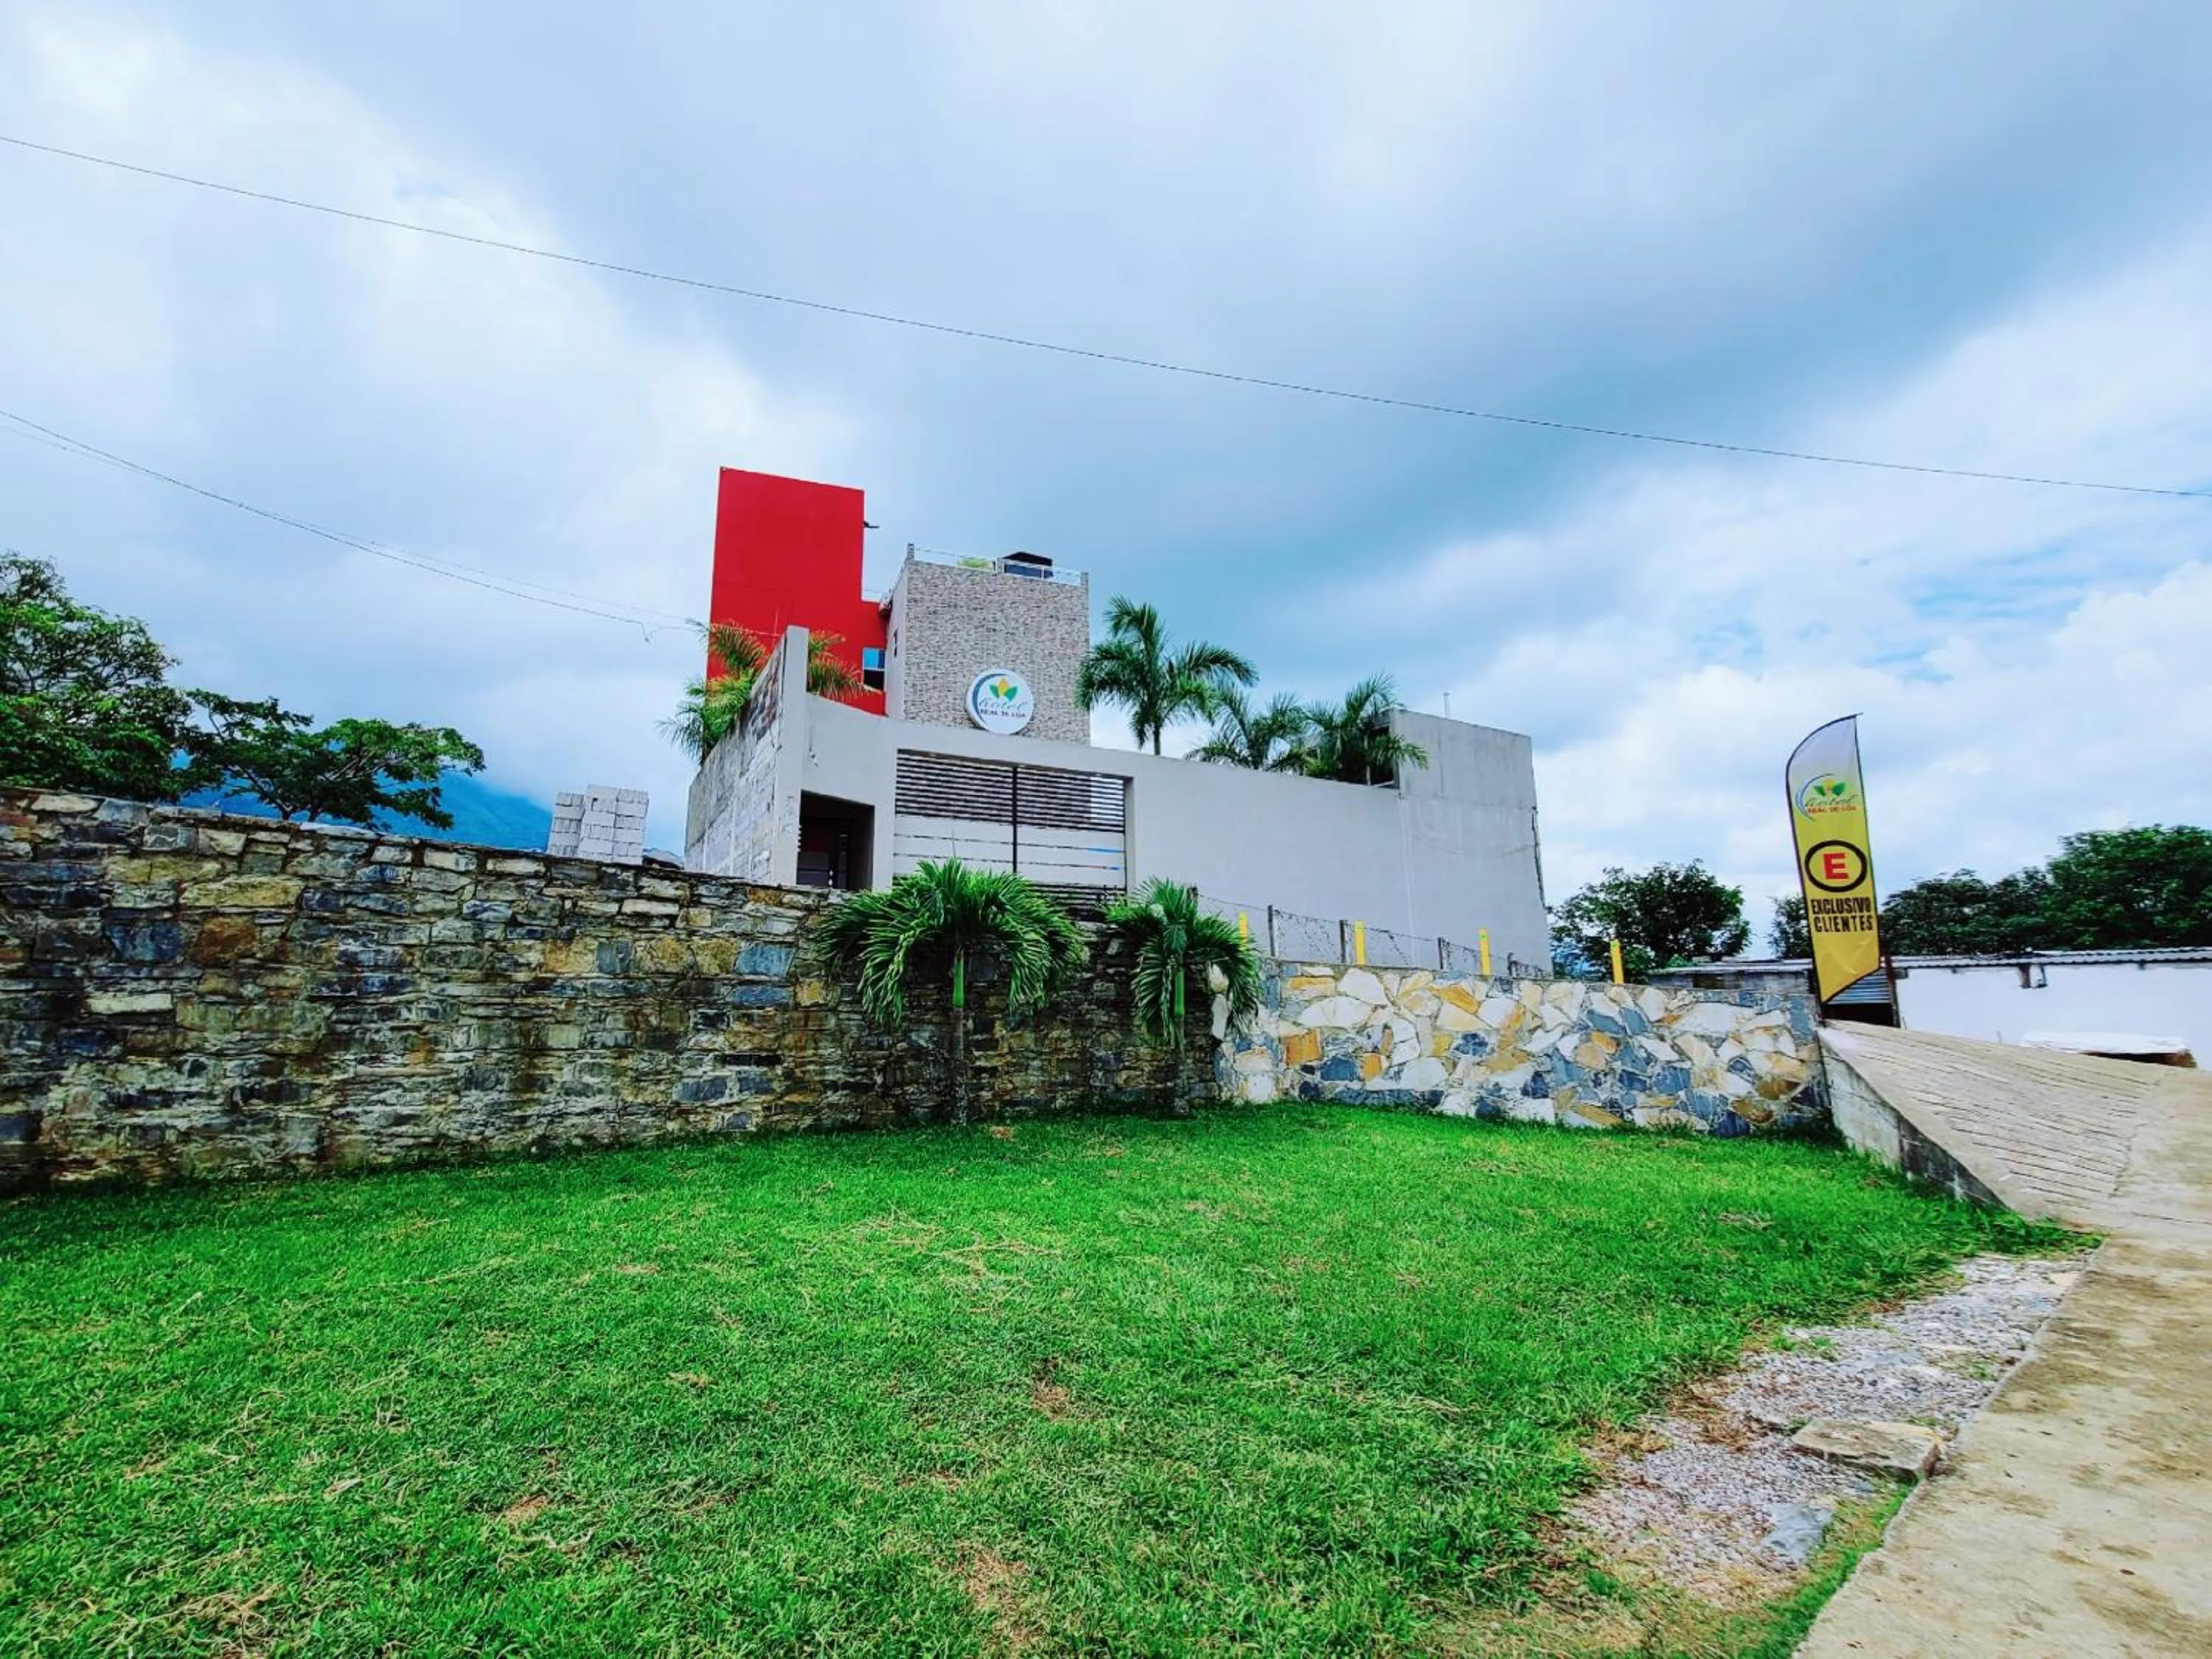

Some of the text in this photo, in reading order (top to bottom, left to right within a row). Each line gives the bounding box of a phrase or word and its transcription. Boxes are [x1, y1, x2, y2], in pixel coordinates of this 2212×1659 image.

[1823, 852, 1849, 880] E
[1811, 897, 1871, 914] EXCLUSIVO
[1814, 915, 1873, 932] CLIENTES
